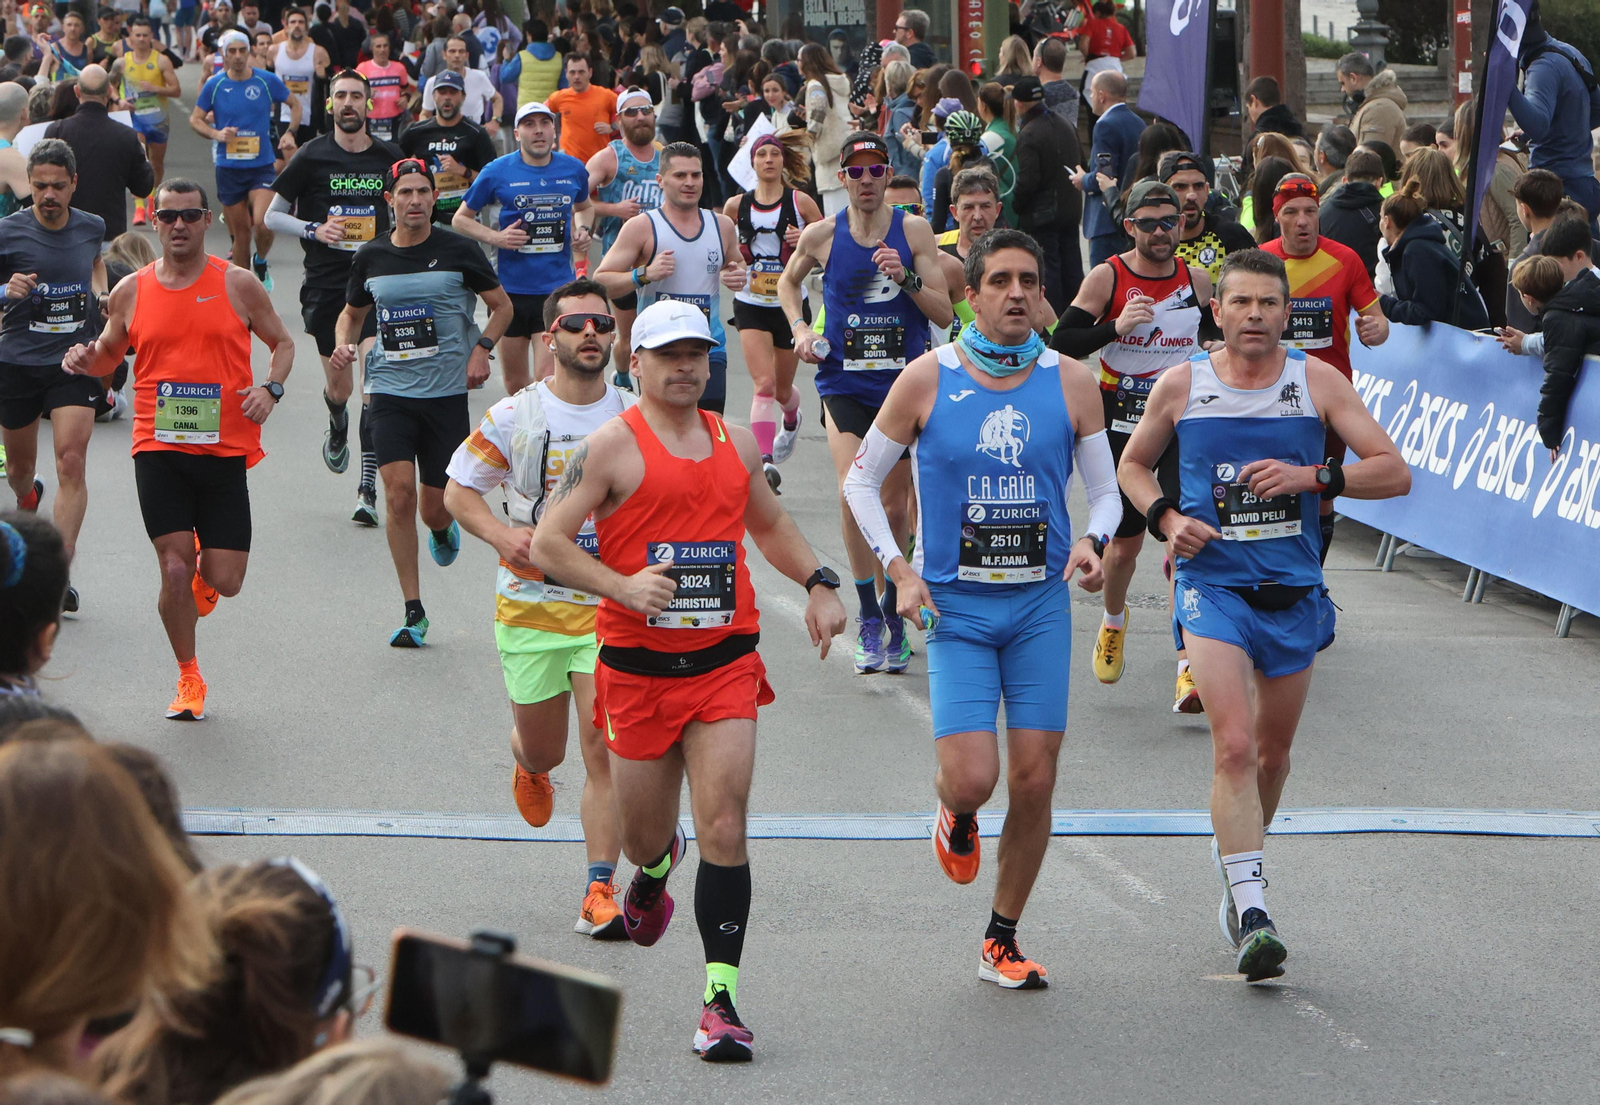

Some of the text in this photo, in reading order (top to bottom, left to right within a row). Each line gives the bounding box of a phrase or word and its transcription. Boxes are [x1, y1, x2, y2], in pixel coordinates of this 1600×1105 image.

[428, 140, 457, 151] PERÚ
[330, 178, 384, 190] CHICAGO
[345, 207, 370, 215] ZURICH
[537, 212, 562, 220] ZURICH
[344, 222, 362, 230] 6052
[536, 226, 552, 234] 2335
[764, 278, 779, 286] 445
[51, 284, 82, 295] ZURICH
[50, 301, 70, 312] 2584
[1292, 300, 1325, 308] ZURICH
[46, 314, 74, 323] WASSIM
[392, 307, 426, 319] ZURICH
[864, 315, 900, 325] ZURICH
[1292, 316, 1313, 326] 3413
[394, 326, 416, 338] 3336
[1293, 330, 1314, 339] SERGI
[863, 333, 886, 345] 2964
[1111, 335, 1145, 346] ALDE
[398, 341, 416, 350] EYAL
[863, 349, 887, 358] SOUTO
[176, 386, 213, 396] ZURICH
[175, 405, 199, 416] 1396
[1126, 413, 1143, 422] LAB
[173, 421, 199, 430] CANAL
[968, 475, 995, 500] C.A.
[991, 506, 1040, 520] ZURICH
[1230, 509, 1286, 525] DAVID PELU
[990, 534, 1021, 547] 2510
[680, 547, 728, 559] ZURICH
[981, 555, 1029, 566] M.F.DANA
[680, 574, 711, 589] 3024
[668, 597, 721, 609] CHRISTIAN
